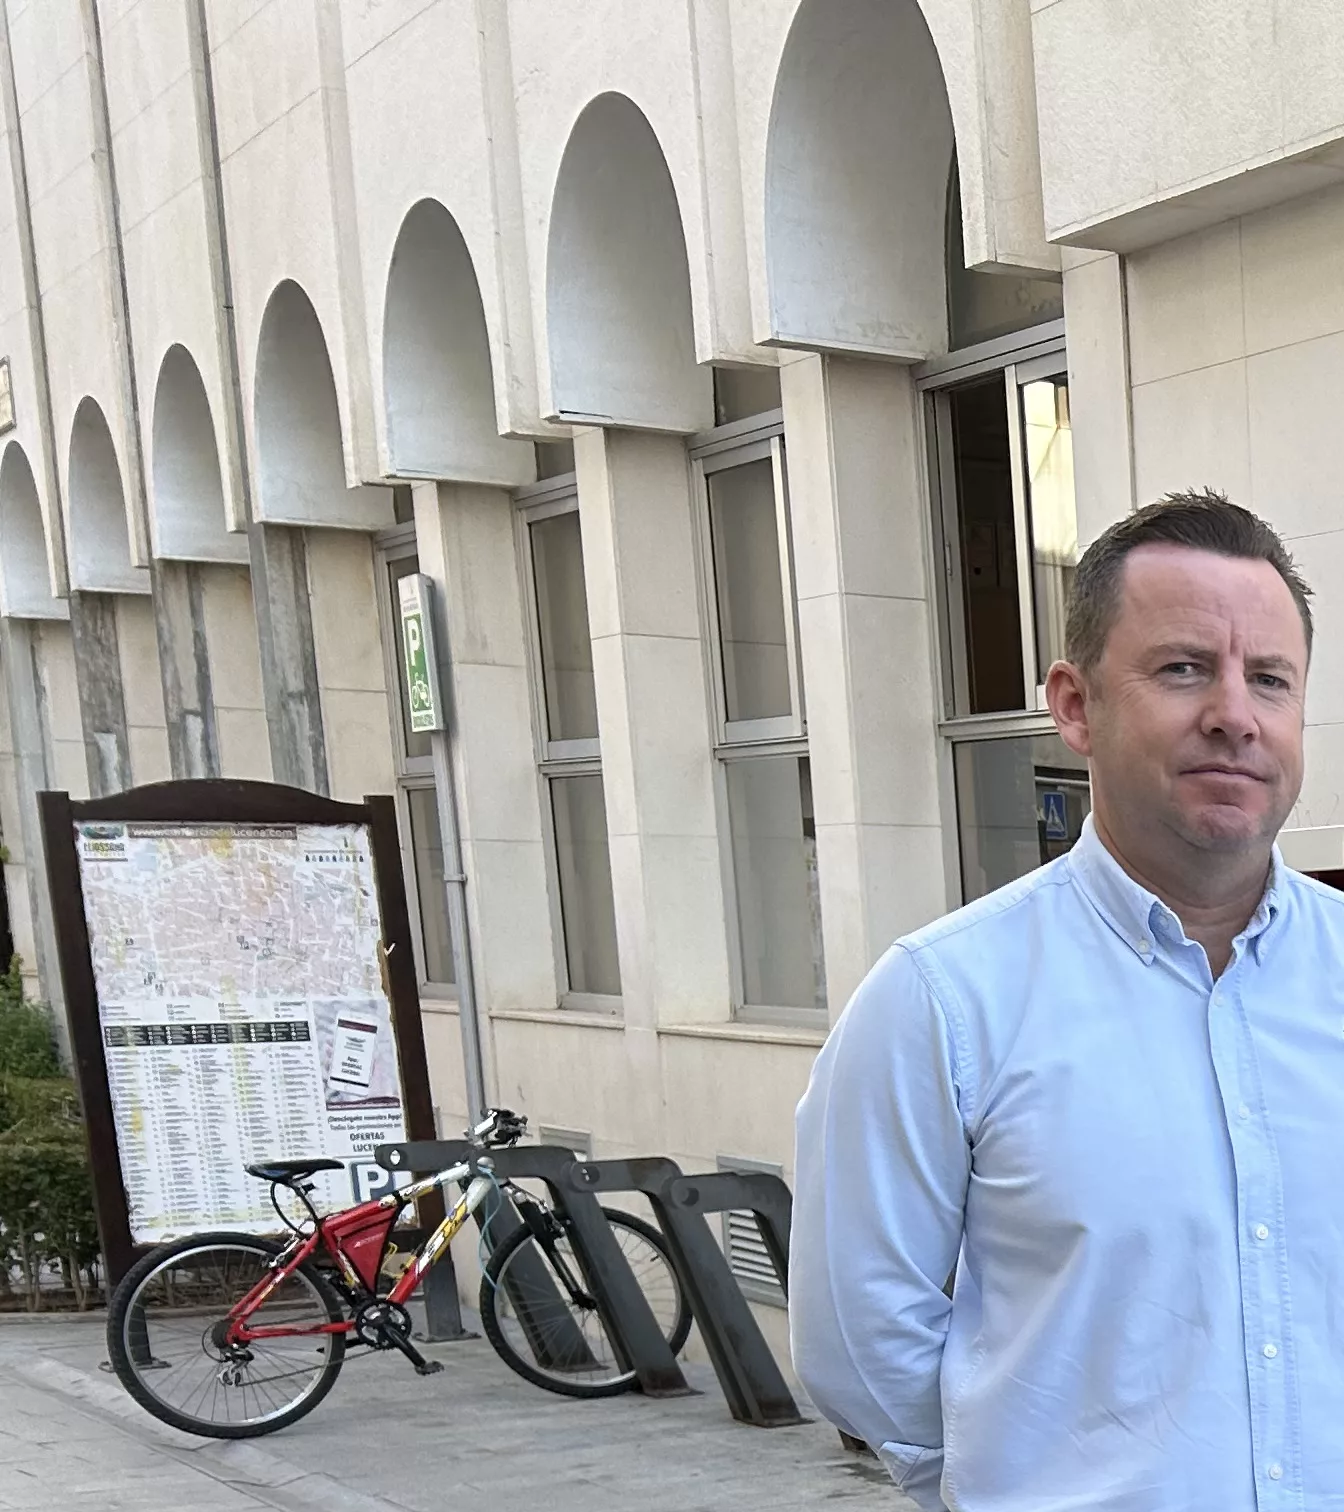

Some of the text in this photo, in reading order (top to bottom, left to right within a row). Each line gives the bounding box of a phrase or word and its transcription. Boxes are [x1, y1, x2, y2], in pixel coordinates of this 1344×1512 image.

[407, 619, 421, 667] P
[349, 1131, 385, 1141] OFERTAS
[357, 1164, 389, 1201] P
